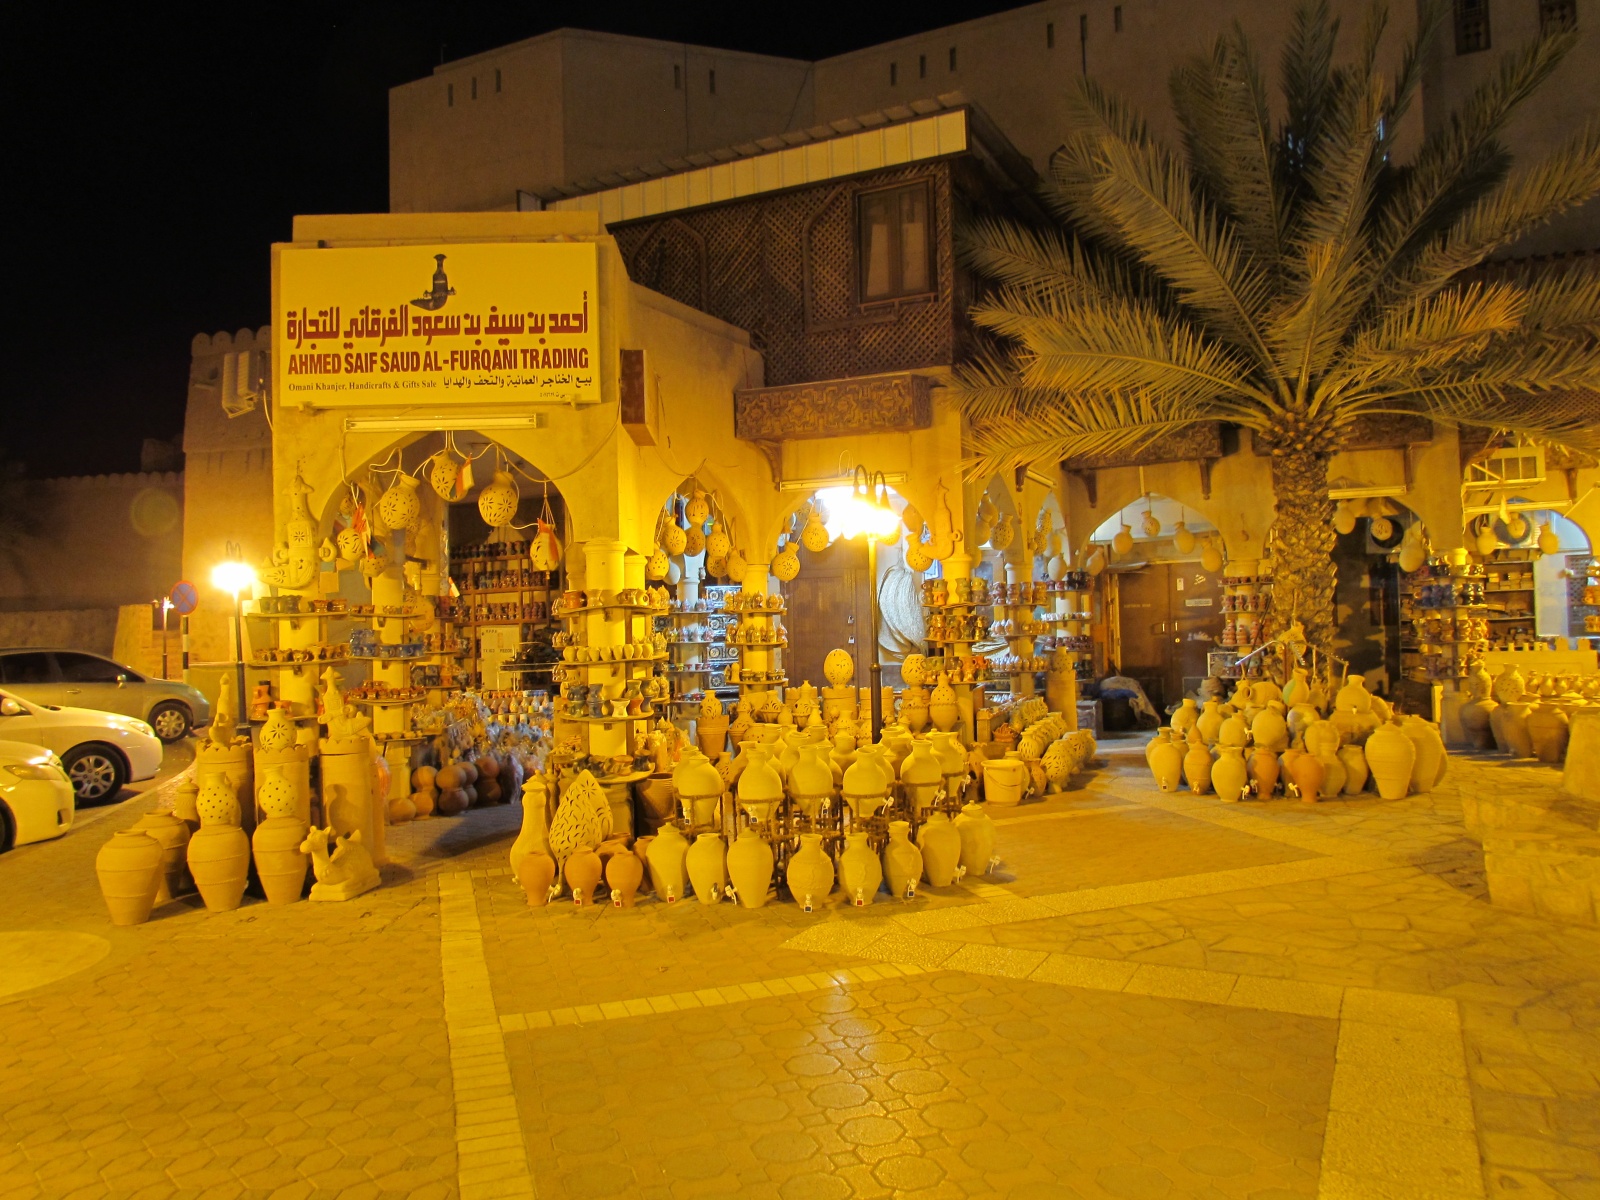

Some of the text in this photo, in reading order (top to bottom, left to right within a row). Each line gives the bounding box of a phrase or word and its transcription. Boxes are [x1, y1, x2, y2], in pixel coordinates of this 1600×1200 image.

[287, 291, 588, 350] أحمد بن سيف بن سعود الفرقاني للتجارة
[288, 348, 589, 375] AHMED SAIF SAUD AL-FURQANI TRADING
[288, 383, 314, 391] Omani
[349, 381, 392, 390] Handicrafts
[393, 381, 400, 389] &
[402, 380, 420, 389] Gifts
[421, 380, 437, 388] Sale
[443, 374, 592, 389] بيع الخناجر العمانية والتحف والهدايا
